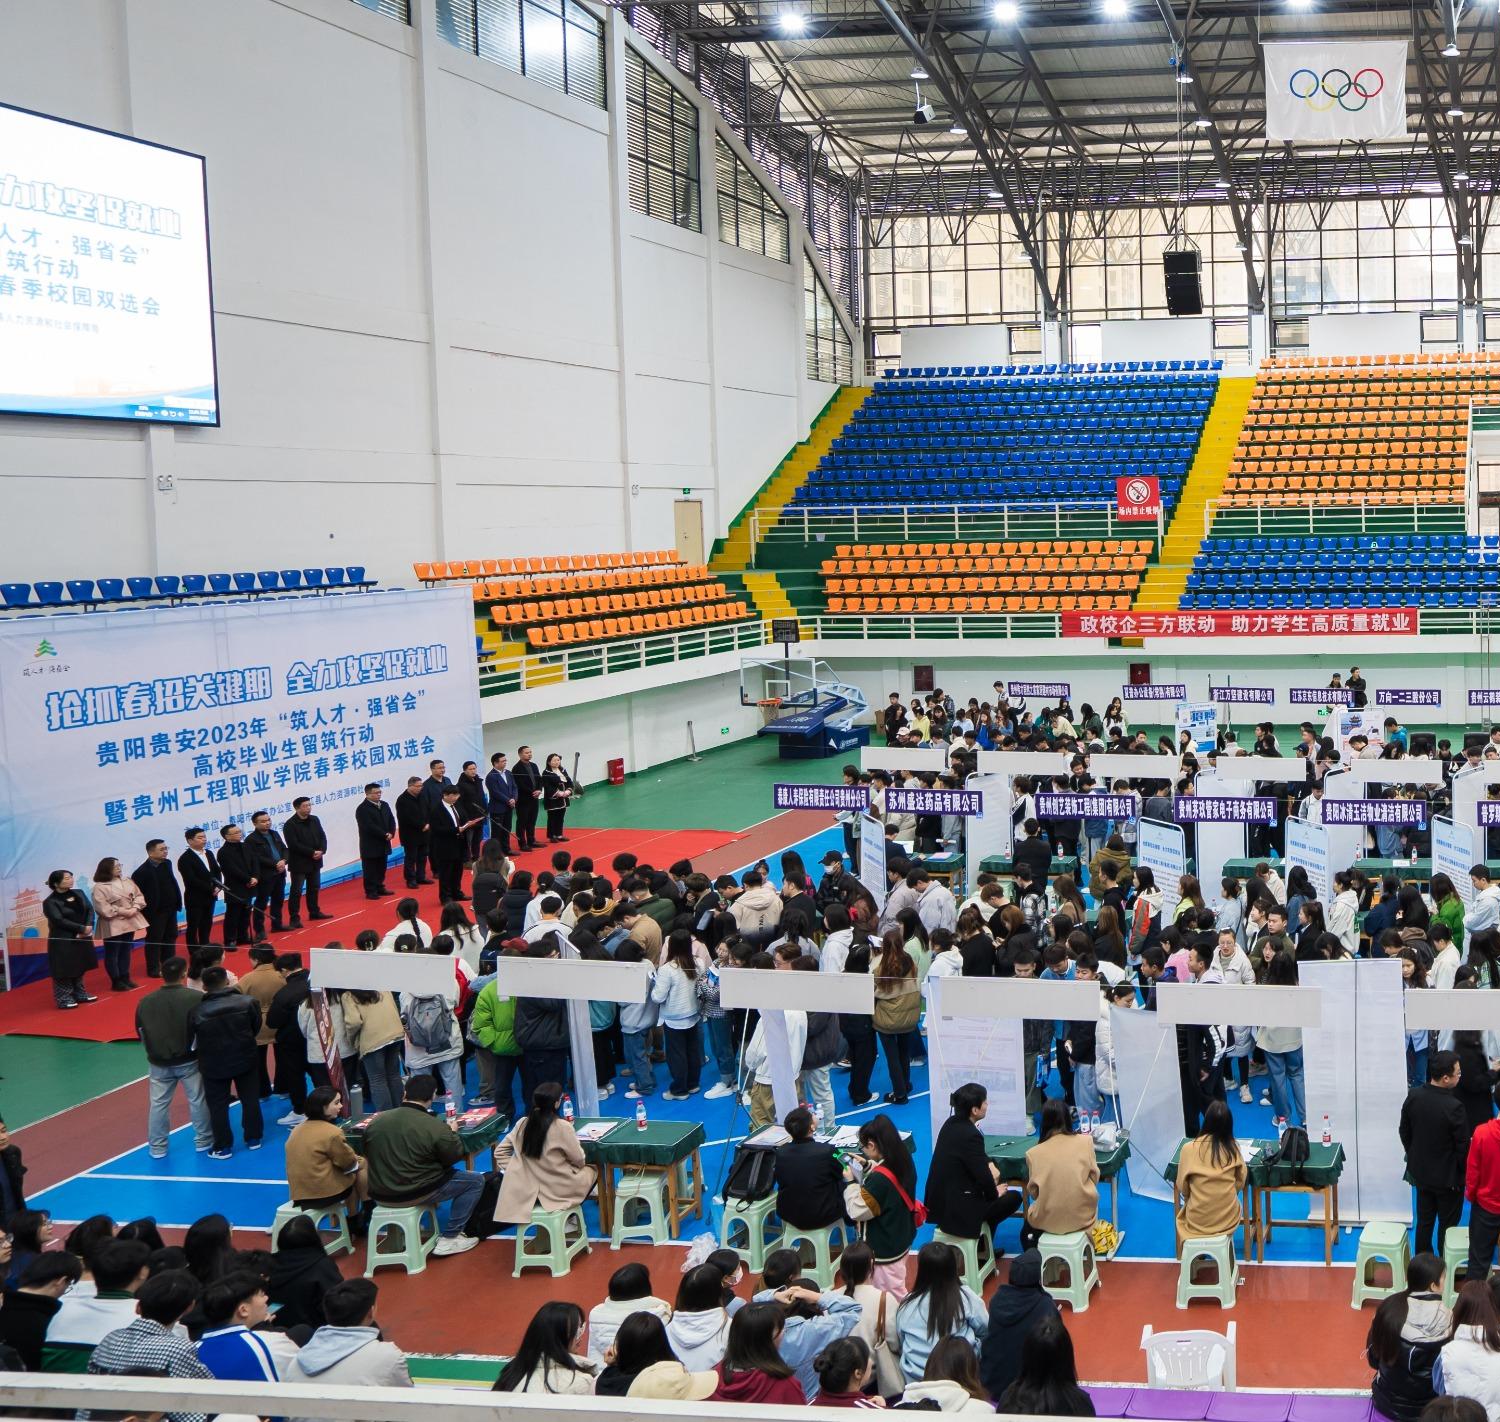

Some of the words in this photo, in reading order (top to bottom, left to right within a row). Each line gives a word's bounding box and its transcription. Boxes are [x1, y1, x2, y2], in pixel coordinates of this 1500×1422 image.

[7, 250, 79, 279] 筑行动
[0, 275, 160, 316] 春季校园双选会
[1080, 615, 1216, 634] 政校企三方联动
[1231, 613, 1411, 633] 助力学生高质量就业
[46, 666, 272, 732] 抢抓春招关键期
[286, 644, 449, 696] 全力攻坚促就业
[1378, 691, 1439, 703] 万向一二三股份公司
[192, 725, 375, 779] 高校毕业生留筑行动
[103, 735, 436, 827] 暨贵州工程职业学院春季校园双选会
[888, 792, 979, 813] 苏州盛达药品有限公司
[1326, 802, 1422, 822] 贵阳冰清玉洁物业清洁有限公司
